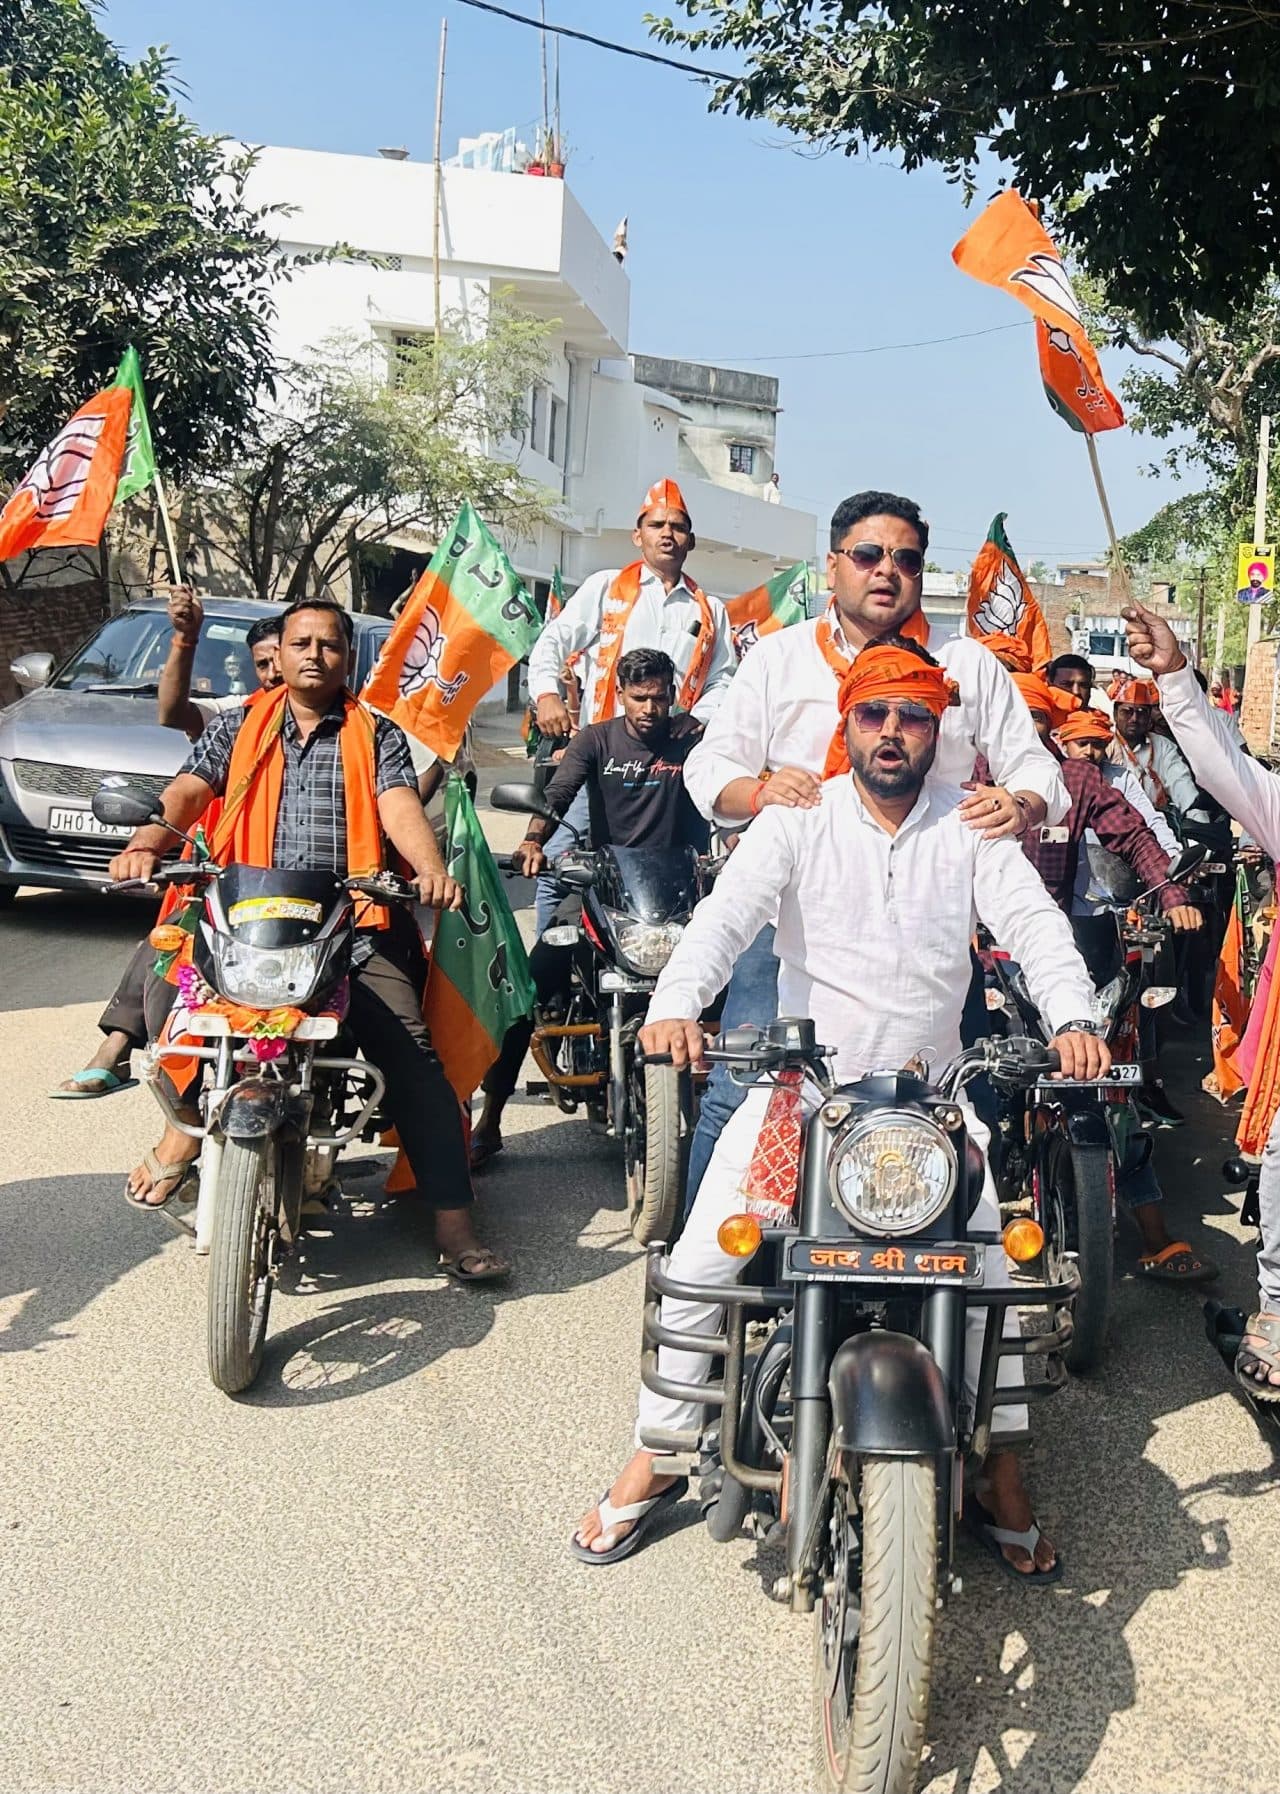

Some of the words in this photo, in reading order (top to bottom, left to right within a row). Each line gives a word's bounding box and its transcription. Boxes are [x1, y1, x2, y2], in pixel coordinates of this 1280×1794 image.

[809, 1249, 861, 1268] जय
[869, 1247, 906, 1271] श्री
[914, 1254, 968, 1273] राम
